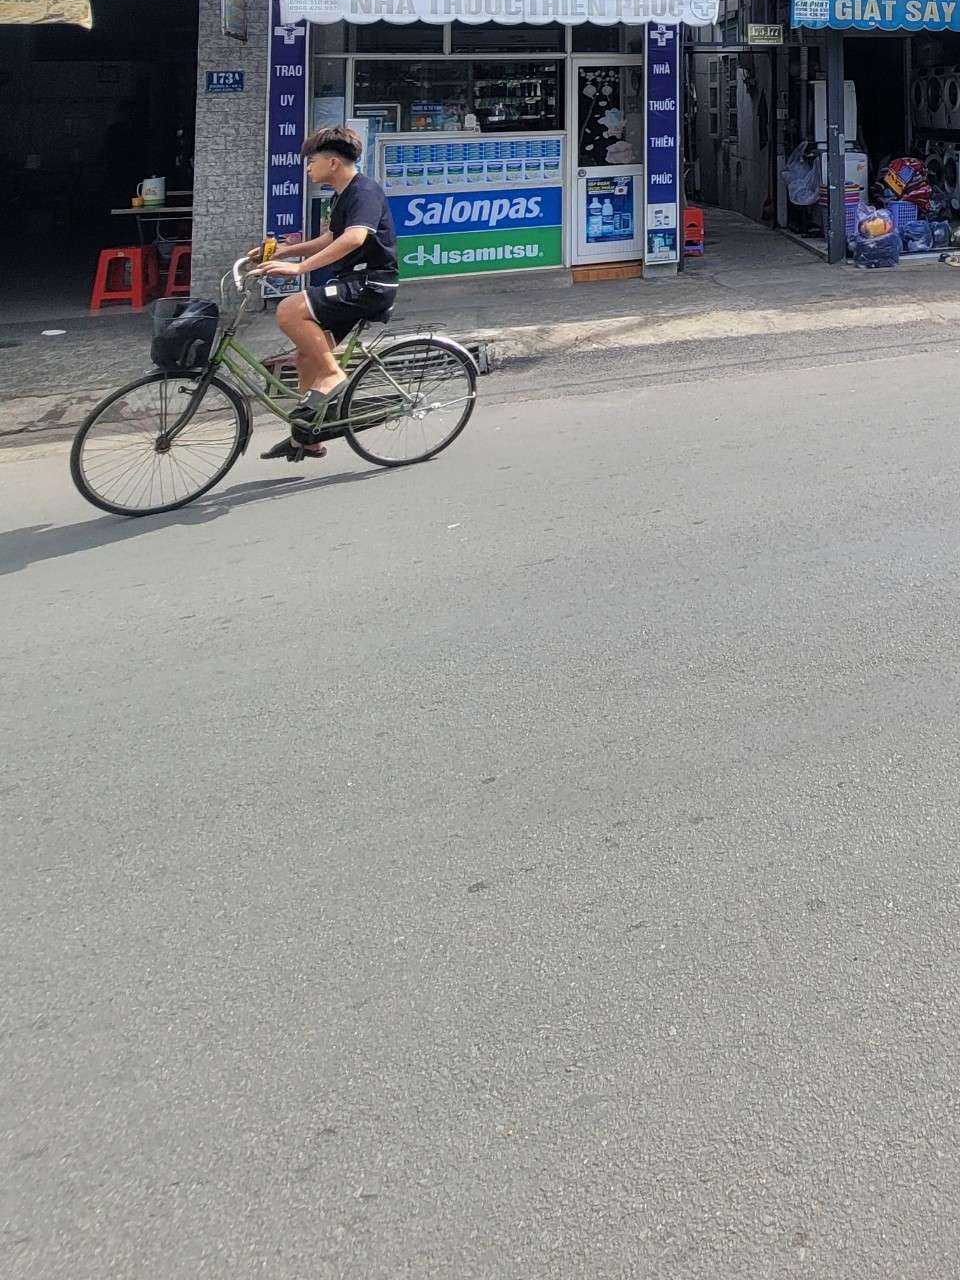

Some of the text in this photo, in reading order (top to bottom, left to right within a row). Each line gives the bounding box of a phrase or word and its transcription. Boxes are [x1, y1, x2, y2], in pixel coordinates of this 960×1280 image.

[212, 72, 240, 85] 173A
[275, 65, 303, 77] TRAO
[280, 94, 295, 107] UY
[278, 121, 296, 136] TÍN
[649, 62, 676, 185] NHÀ THUỐC THIÊN PHÚC
[272, 151, 301, 168] NHẬN
[404, 195, 542, 227] Salonpas
[276, 213, 294, 226] TIN
[404, 243, 540, 267] Hisamitsu
